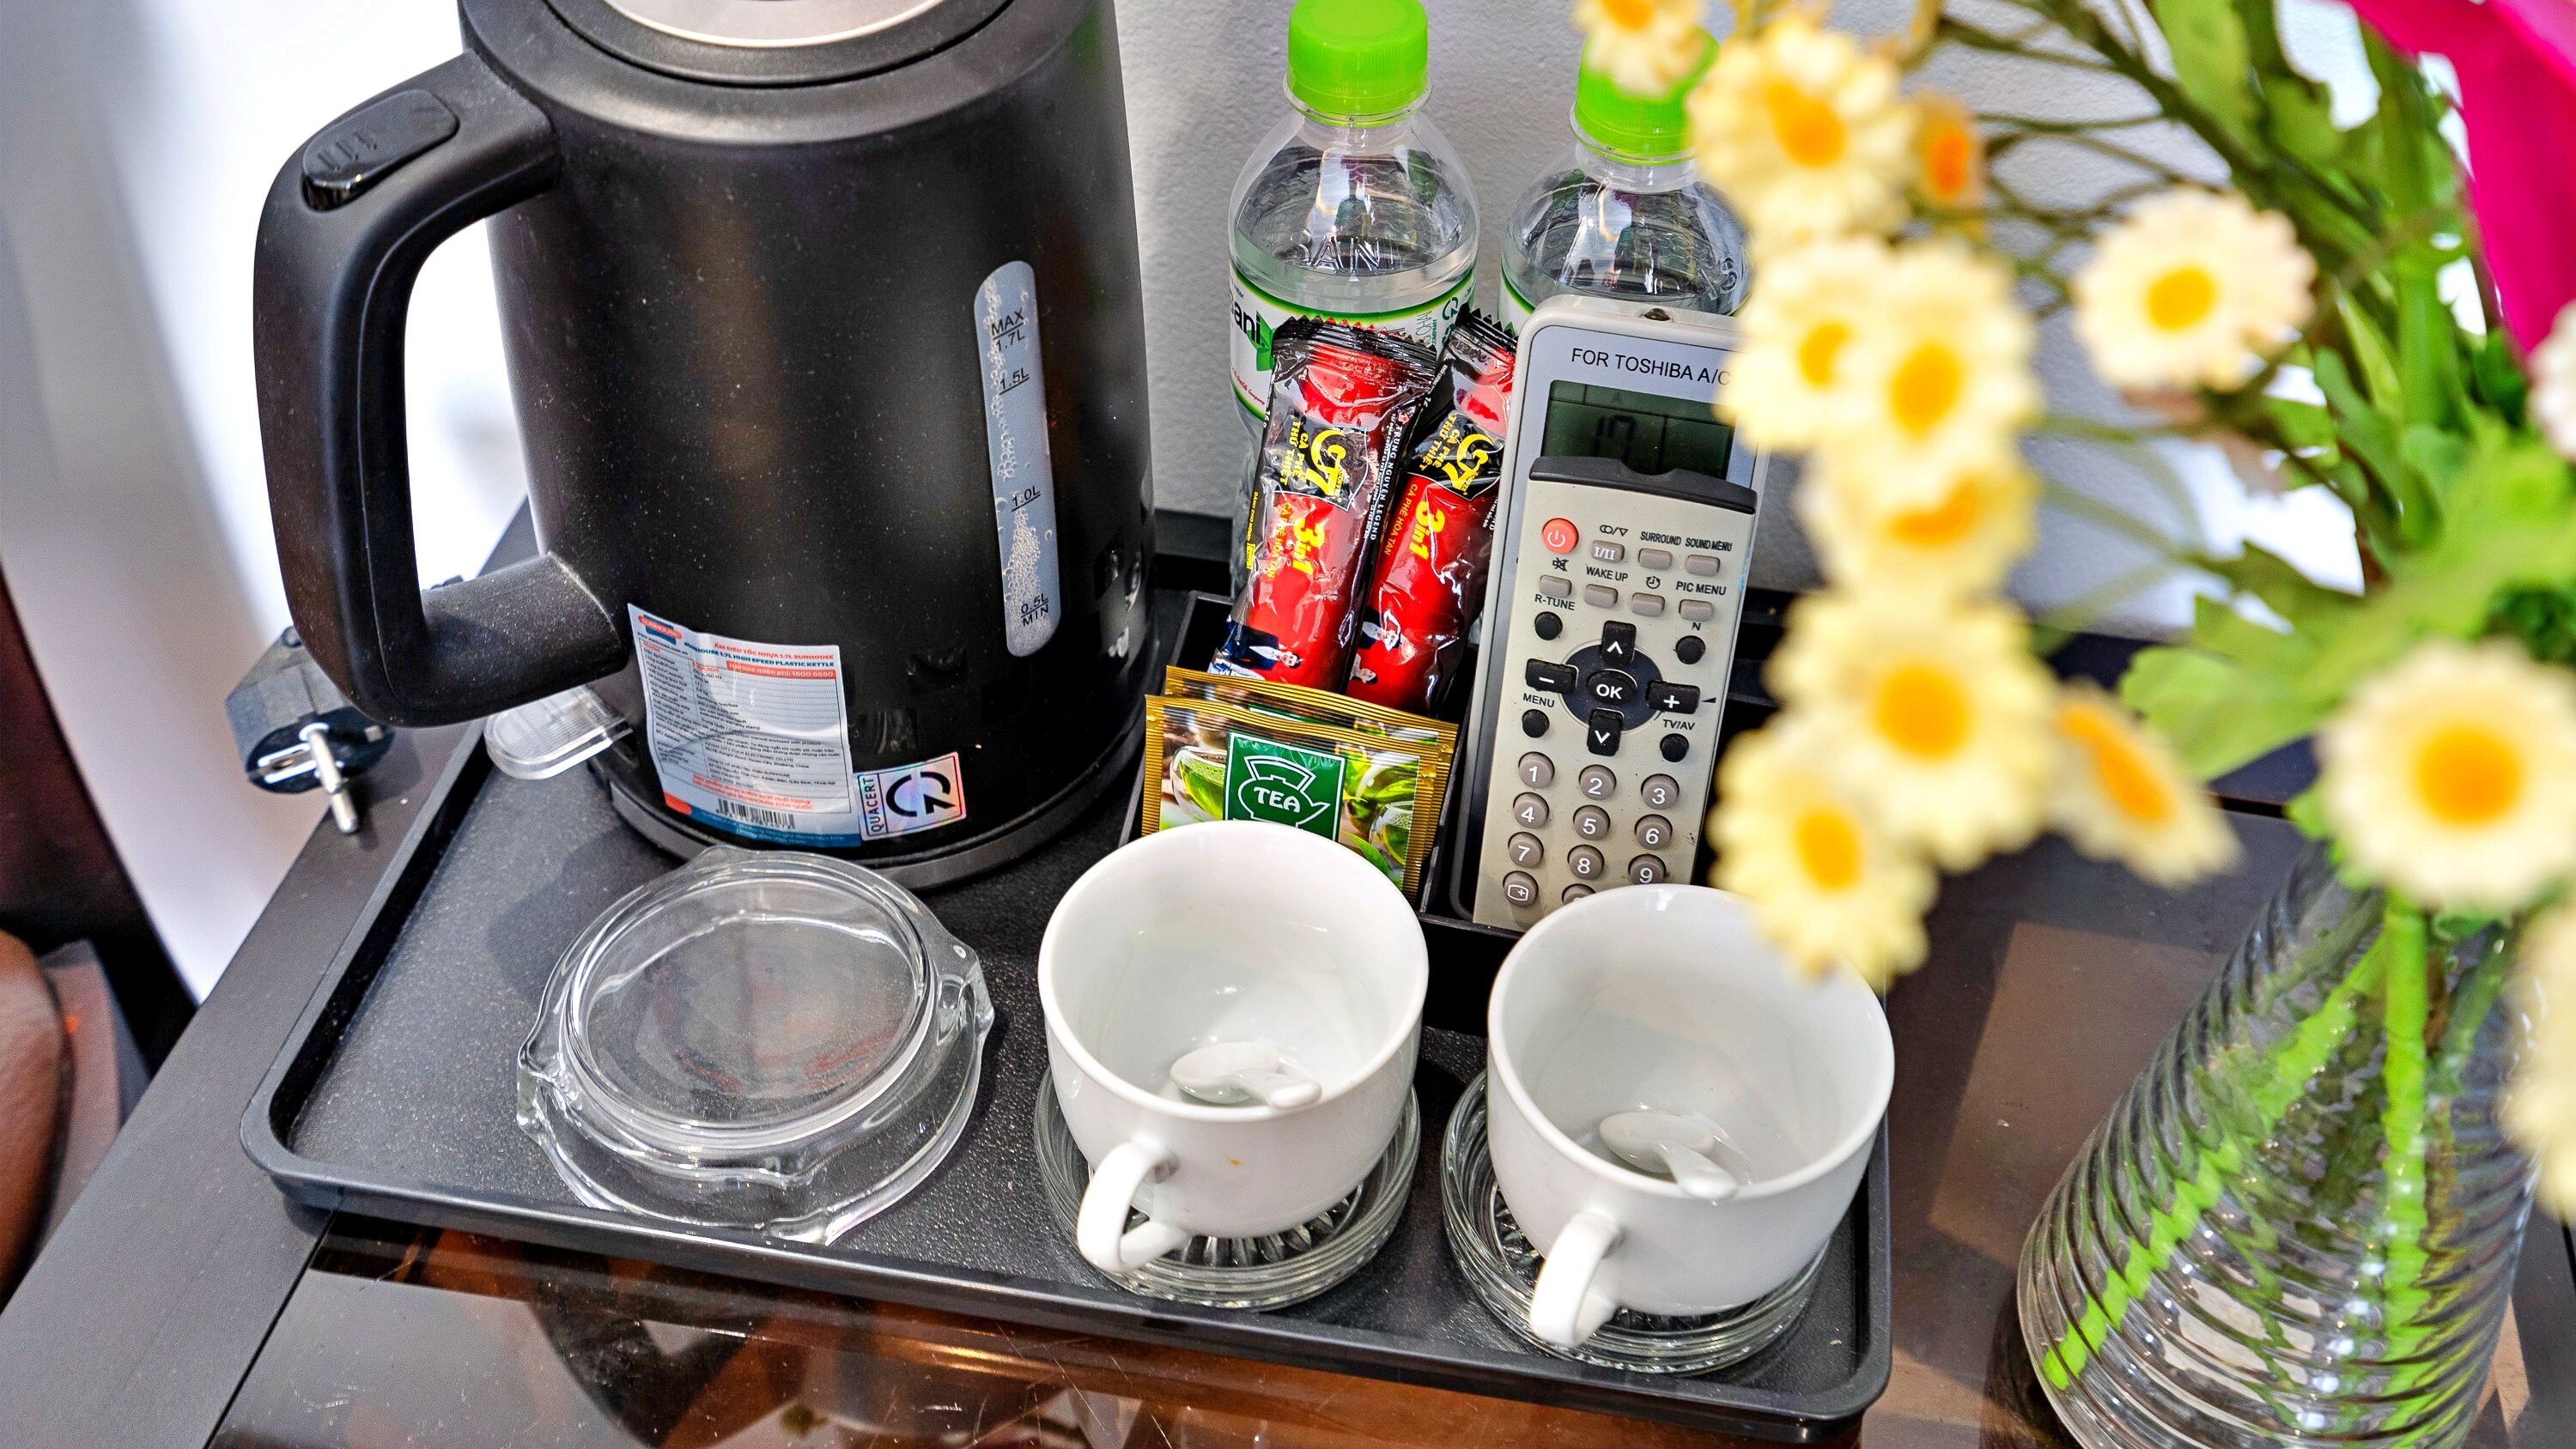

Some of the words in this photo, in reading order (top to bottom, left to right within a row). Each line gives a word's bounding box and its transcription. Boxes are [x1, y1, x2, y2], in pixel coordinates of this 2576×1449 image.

[991, 308, 1024, 336] MAX
[996, 331, 1025, 353] 1.7L
[1571, 348, 1609, 367] FOR
[1614, 354, 1692, 380] TOSHIBA
[1697, 367, 1731, 385] A/C
[999, 367, 1030, 391] 1.5L
[1391, 423, 1402, 459] TRUNG
[1442, 433, 1494, 490] G7
[1380, 462, 1394, 501] NGUYÊN
[1012, 485, 1041, 507] 1.0L
[1400, 497, 1412, 517] PHÊ
[1370, 504, 1384, 541] LEGEND
[1391, 516, 1404, 537] HÒA
[1408, 500, 1446, 560] 3in1
[1292, 517, 1326, 576] 3in1
[1384, 537, 1396, 556] TAN
[1640, 531, 1681, 546] SURROUND
[1685, 537, 1711, 549] SOUND
[1711, 541, 1733, 552] MENU
[1586, 566, 1613, 579] WAKE
[1614, 571, 1629, 582] UP
[1676, 581, 1695, 593] PIC
[1696, 584, 1727, 596] MENU
[1021, 592, 1049, 615] 0.5L
[1534, 594, 1576, 611] R-TUNE
[1023, 607, 1049, 627] MIN
[1522, 693, 1555, 708] MENU
[1596, 684, 1623, 700] OK
[1662, 718, 1695, 731] TV/AV
[1528, 765, 1538, 783] 1
[1588, 778, 1602, 796] 2
[1651, 788, 1666, 804] 3
[863, 778, 884, 832] QUACERT
[1253, 785, 1301, 814] TEA
[1521, 806, 1535, 823] 4
[1583, 817, 1596, 835] 5
[1645, 828, 1660, 845] 6
[1517, 846, 1531, 862] 7
[1577, 858, 1591, 875] 8
[1639, 867, 1653, 883] 9
